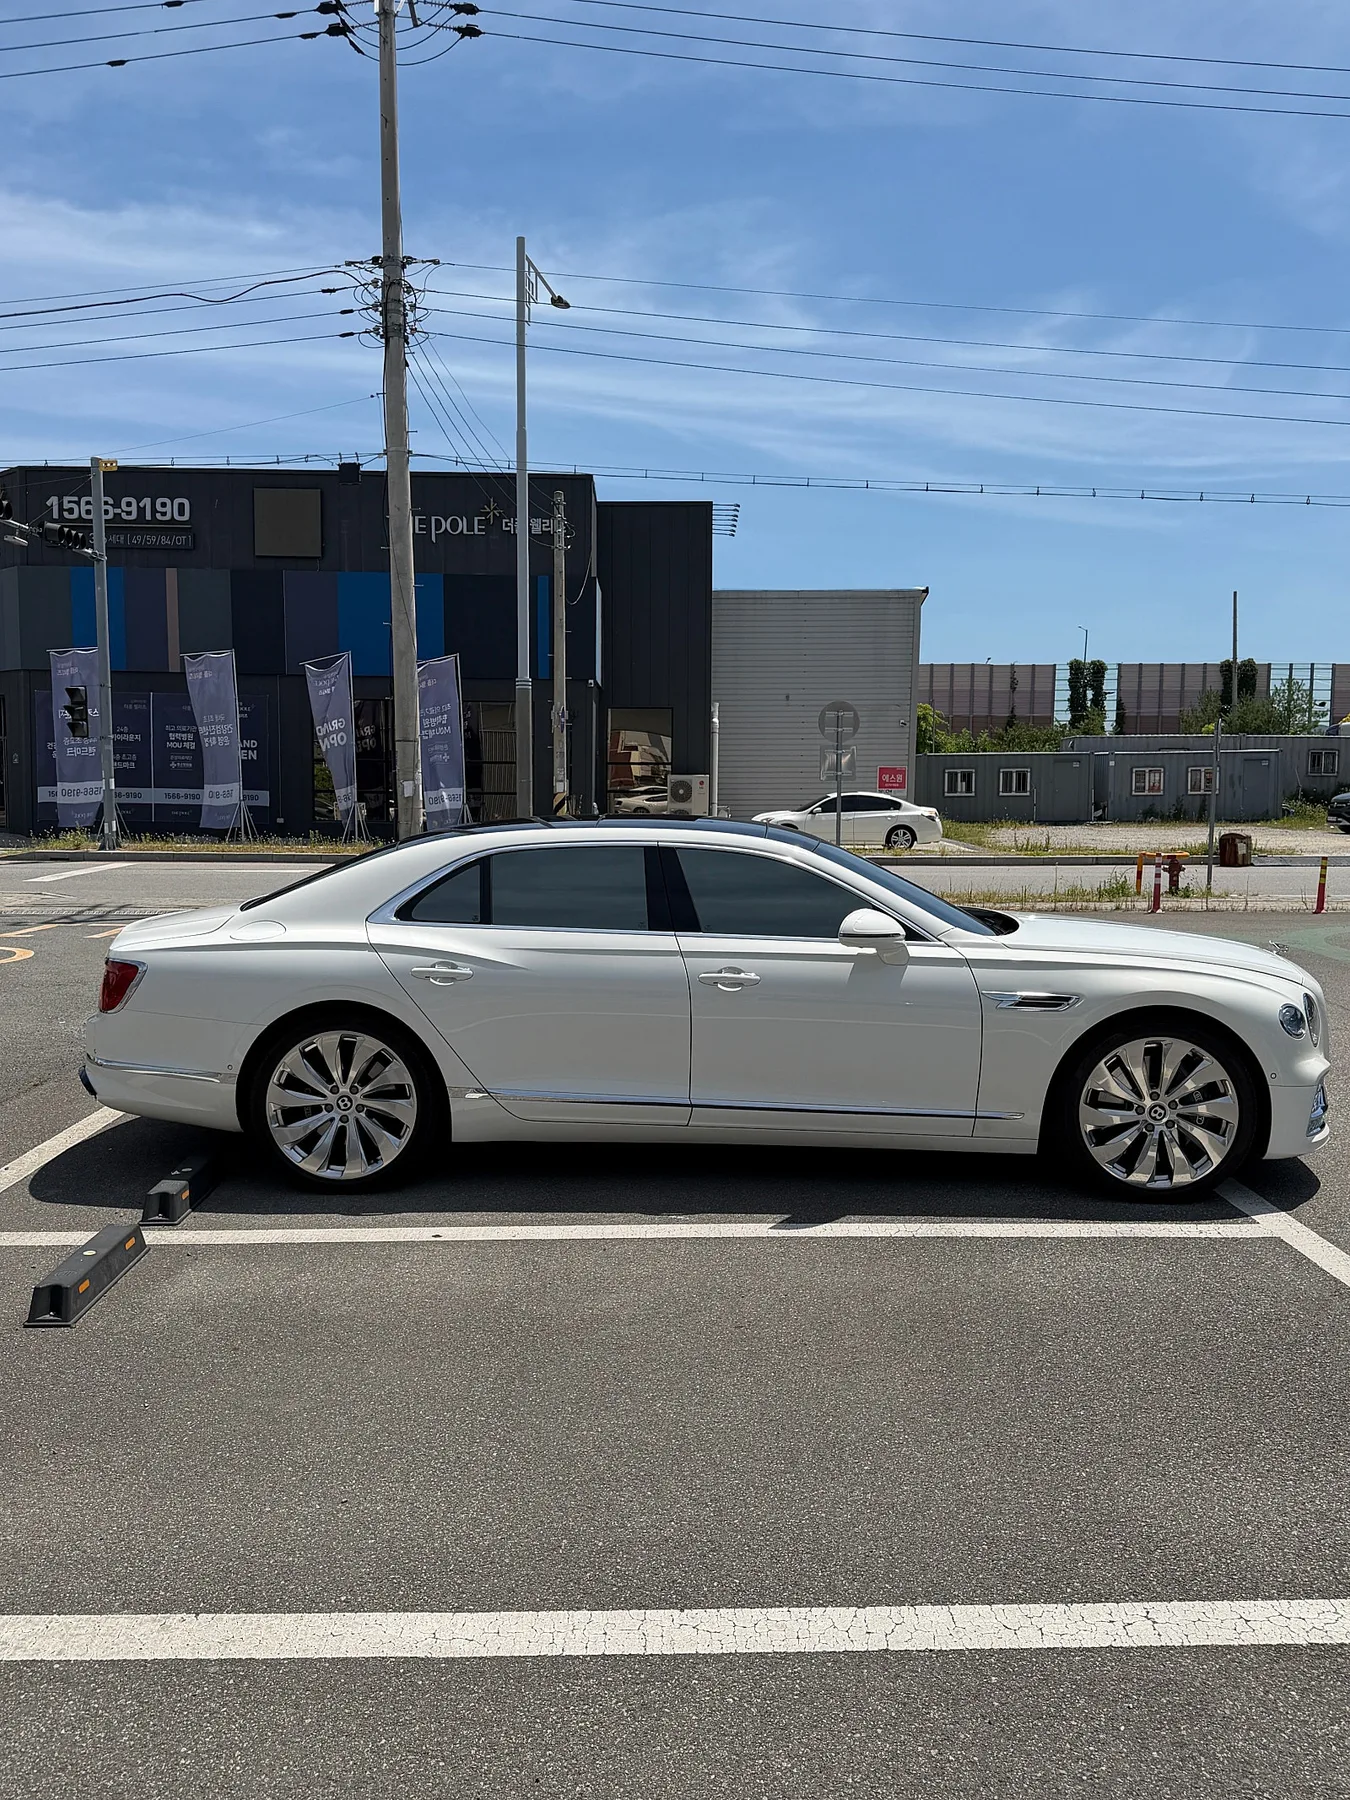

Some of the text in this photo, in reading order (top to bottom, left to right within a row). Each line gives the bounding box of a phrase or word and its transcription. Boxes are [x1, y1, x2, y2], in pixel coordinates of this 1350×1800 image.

[45, 495, 191, 521] 1566-9190
[431, 515, 486, 543] POLE
[502, 517, 518, 534] 더
[240, 751, 258, 760] EN
[164, 792, 202, 800] 1566-9190
